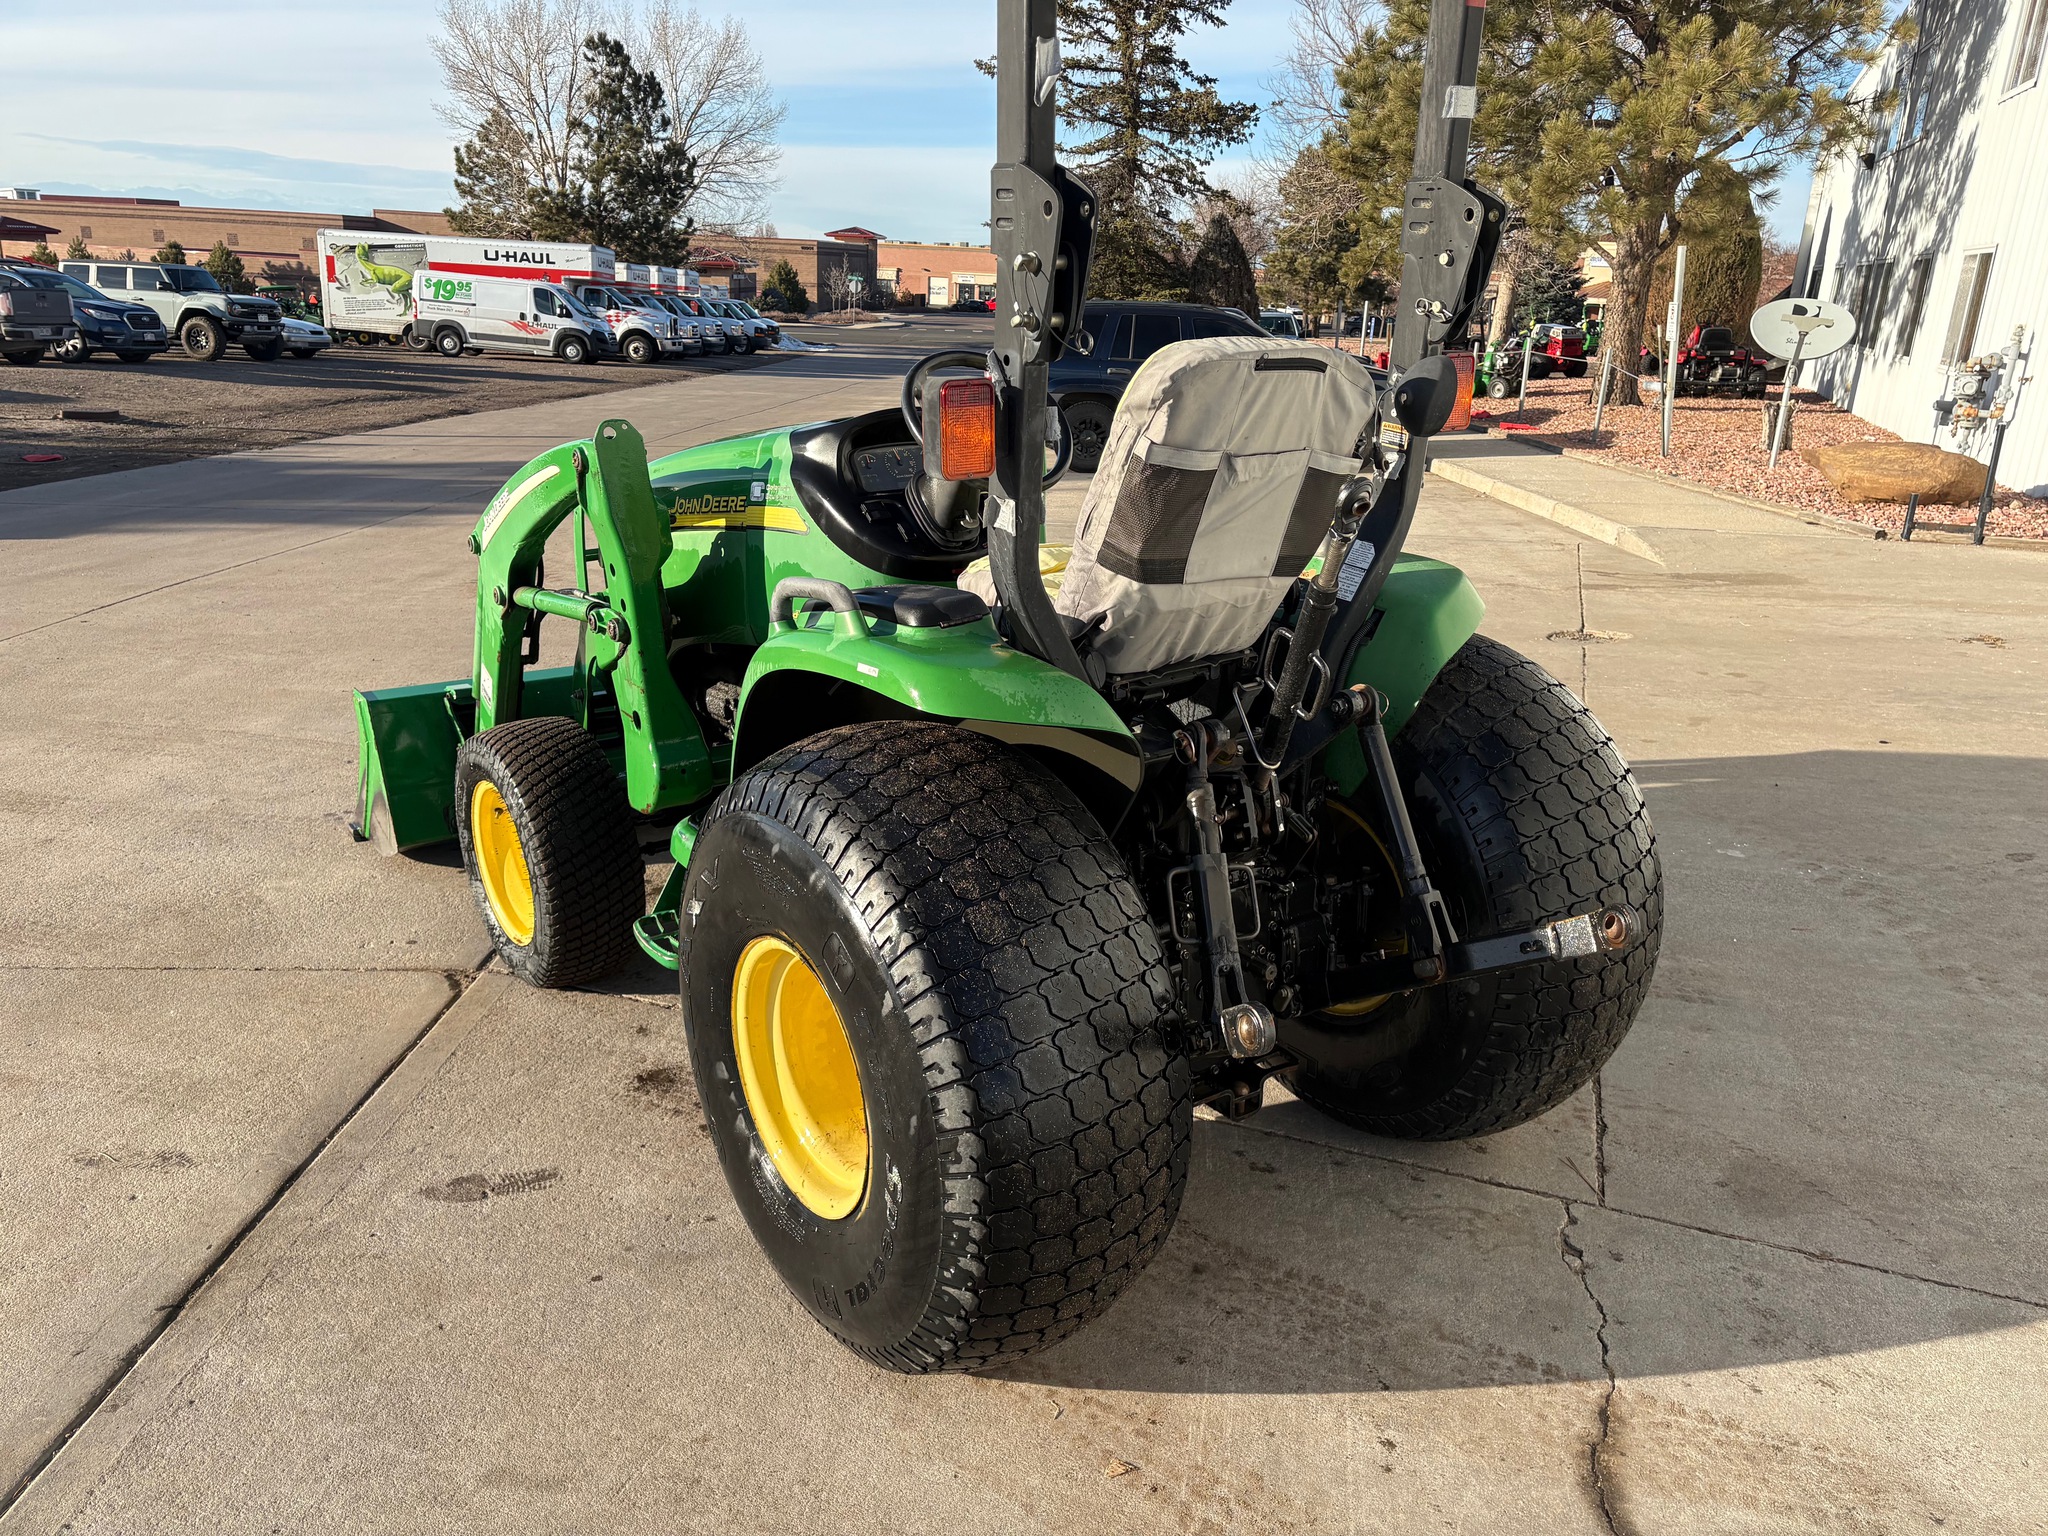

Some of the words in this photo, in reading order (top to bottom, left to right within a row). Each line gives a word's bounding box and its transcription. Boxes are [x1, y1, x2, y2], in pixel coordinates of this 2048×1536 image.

[484, 249, 556, 265] U-HAUL
[527, 321, 559, 330] U-HAUL
[670, 496, 701, 515] JOHN
[700, 494, 747, 513] DEERE
